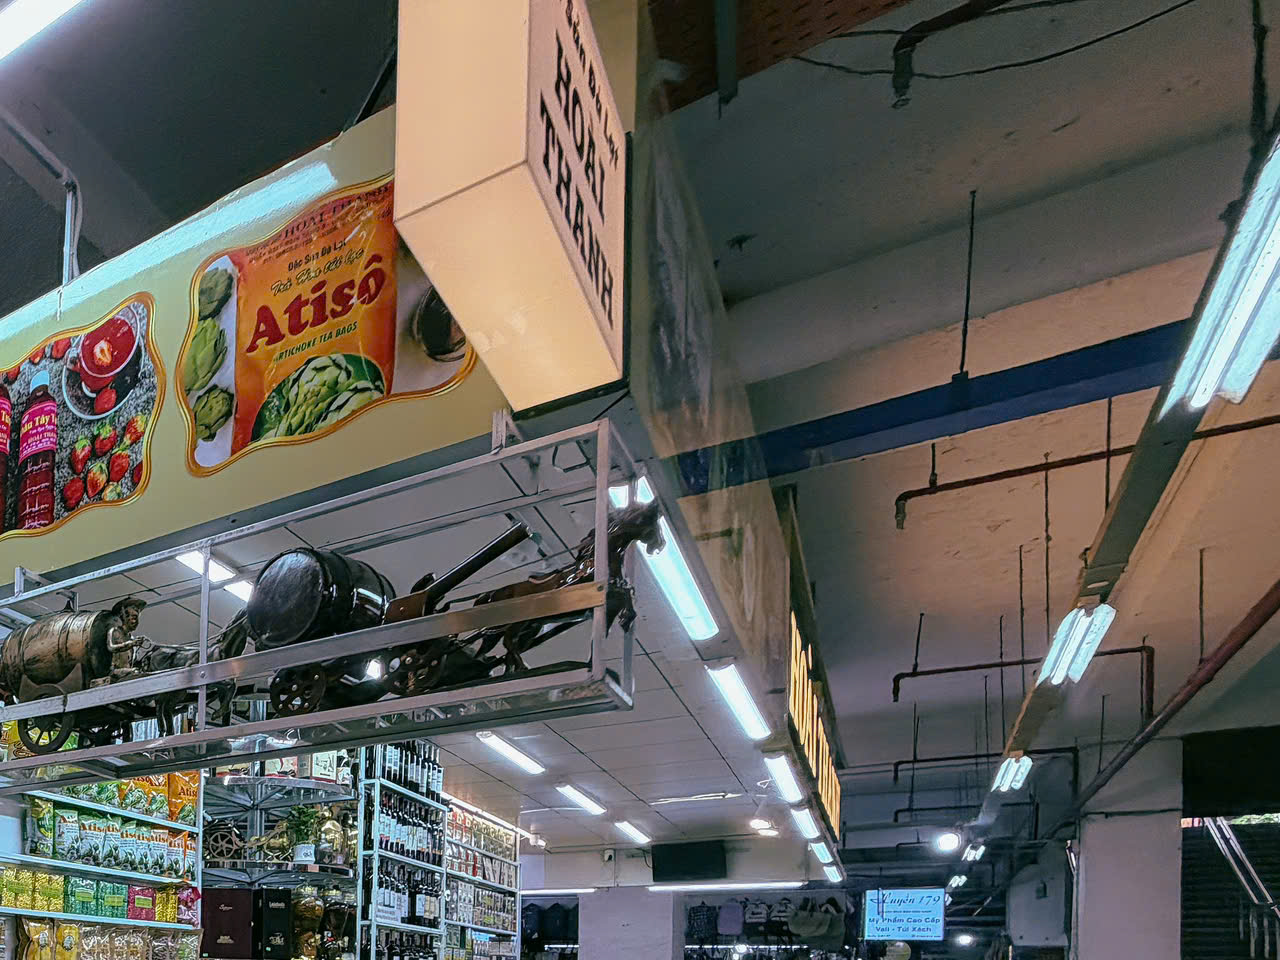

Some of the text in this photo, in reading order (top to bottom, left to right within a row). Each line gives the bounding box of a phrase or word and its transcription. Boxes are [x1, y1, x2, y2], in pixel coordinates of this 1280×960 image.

[554, 28, 605, 227] HOÀI
[540, 88, 614, 331] THANH
[246, 253, 386, 354] Atisô
[320, 332, 333, 345] TEA
[335, 321, 358, 339] BAGS
[919, 895, 941, 906] 179
[924, 916, 940, 924] Cấp
